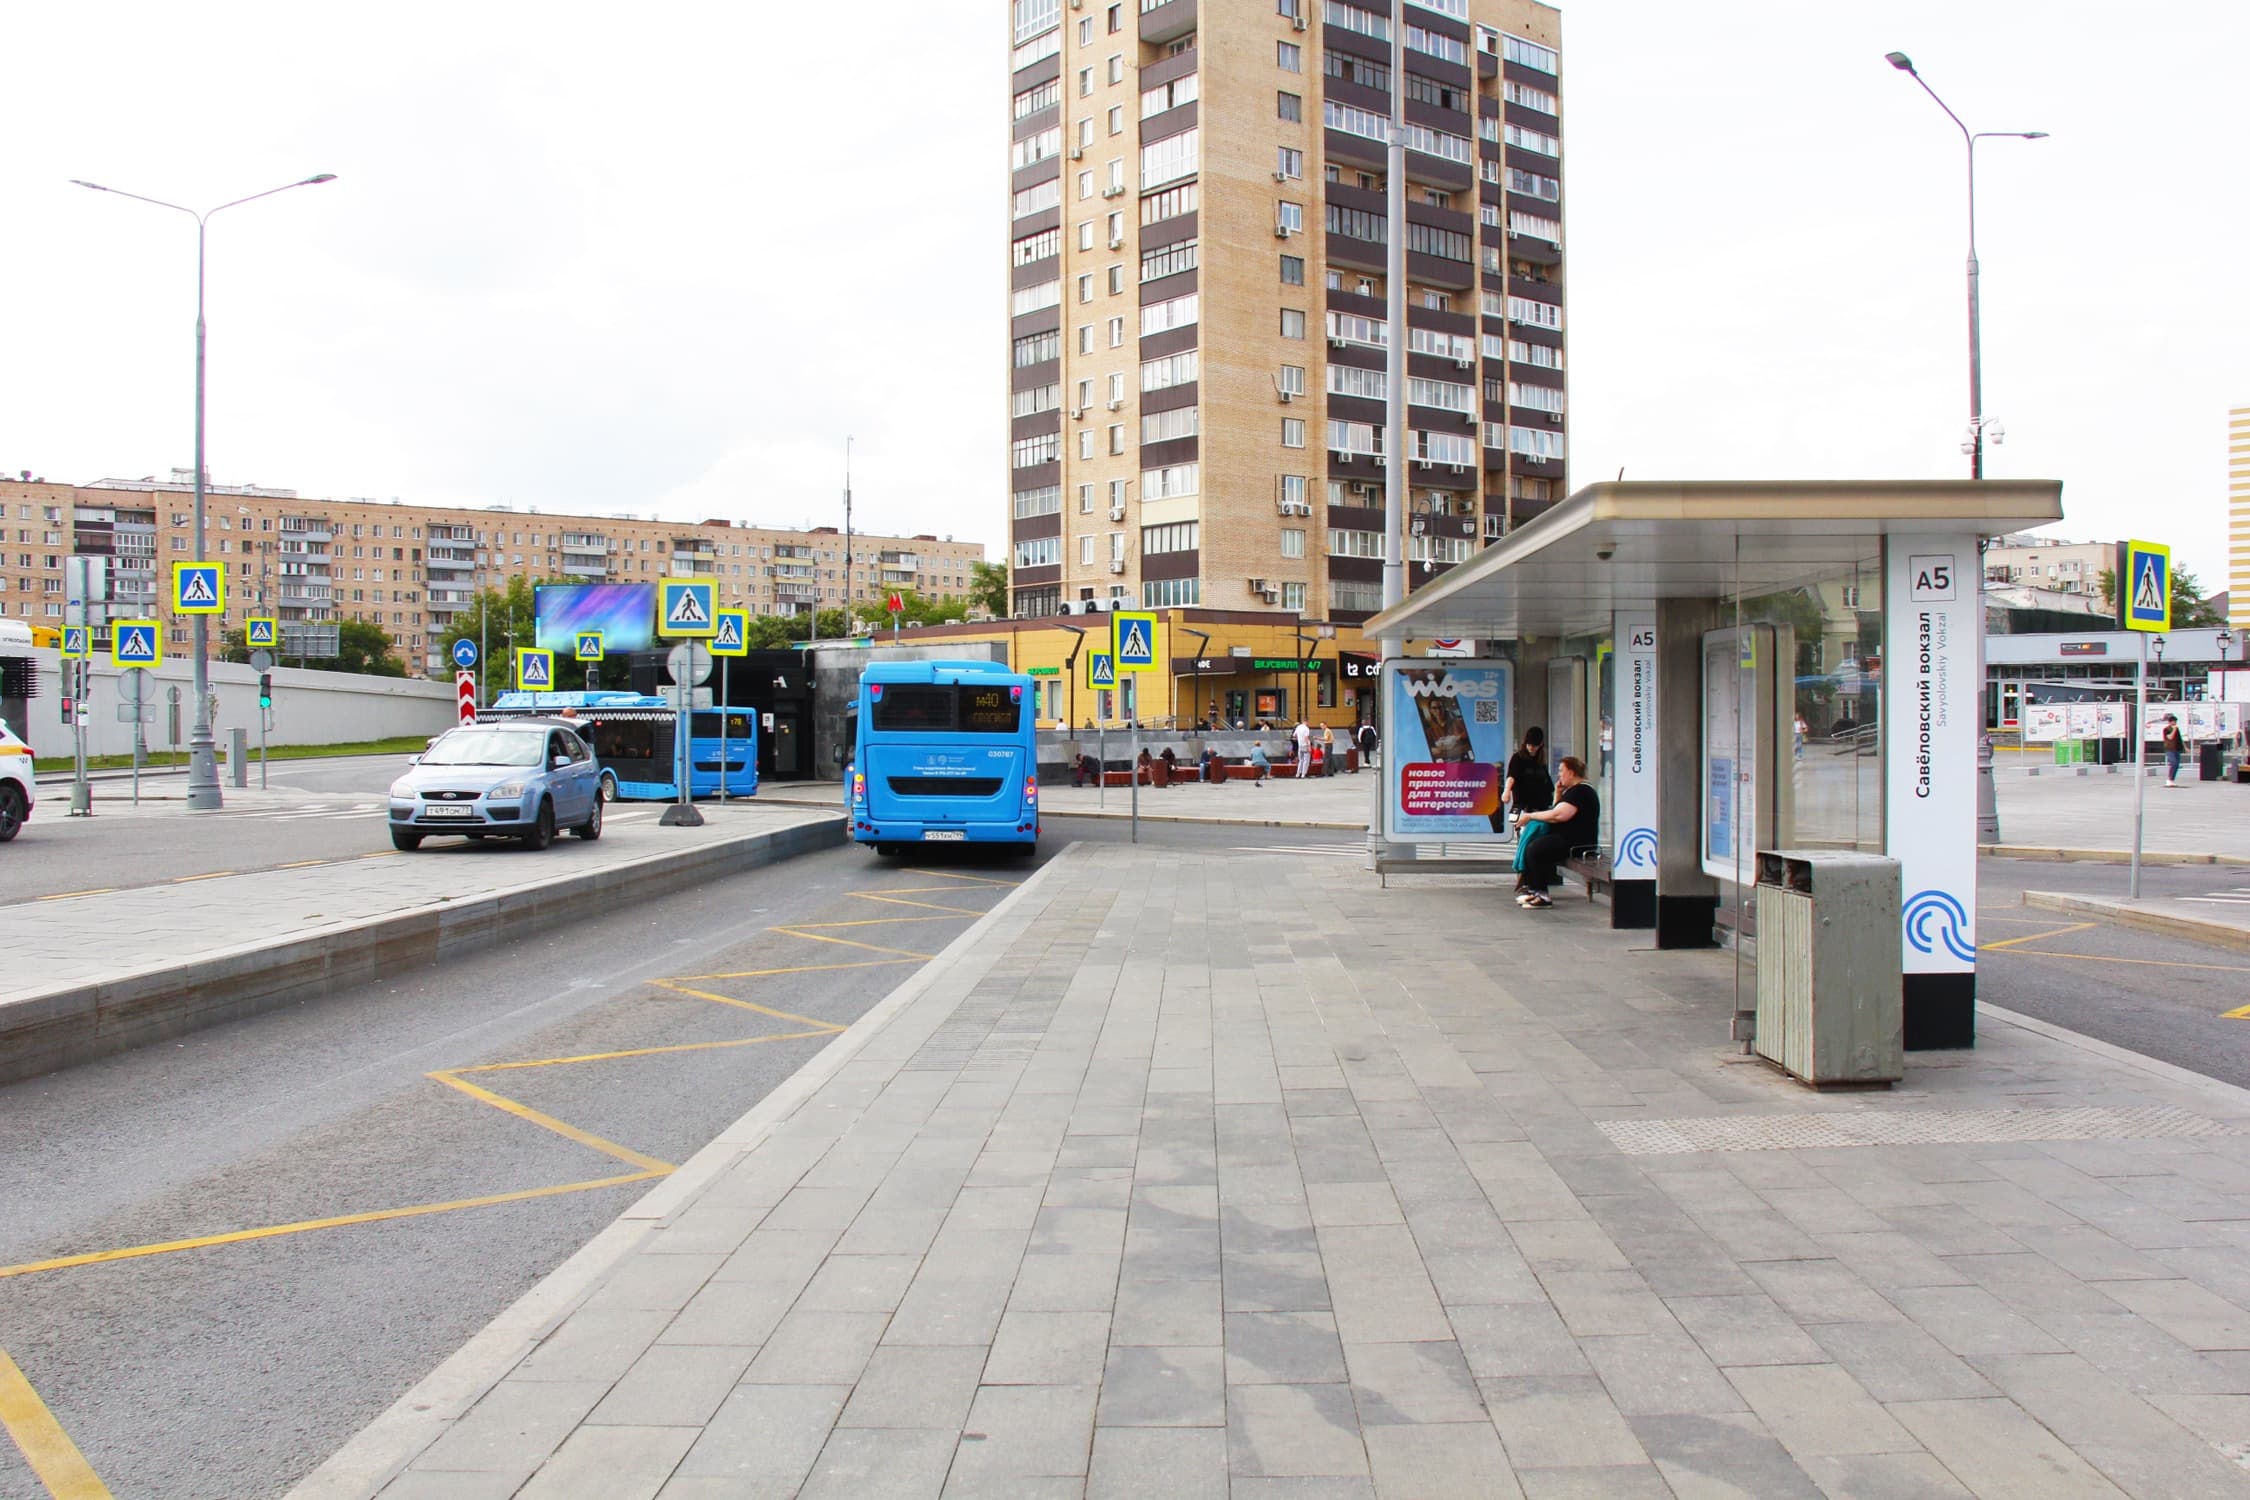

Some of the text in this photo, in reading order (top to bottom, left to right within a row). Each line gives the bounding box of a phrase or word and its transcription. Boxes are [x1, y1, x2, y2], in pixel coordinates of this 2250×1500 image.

[1303, 660, 1321, 670] 4/7
[1347, 662, 1359, 676] t2
[1936, 612, 1949, 728] Savyolovskiy Vokzal
[1916, 612, 1931, 798] Савёловский вокзал
[1632, 659, 1642, 774] Савёловский вокзал
[1408, 769, 1446, 777] новое
[1408, 780, 1487, 790] приложение
[1407, 790, 1470, 799] для твоих
[1407, 801, 1474, 811] интересов
